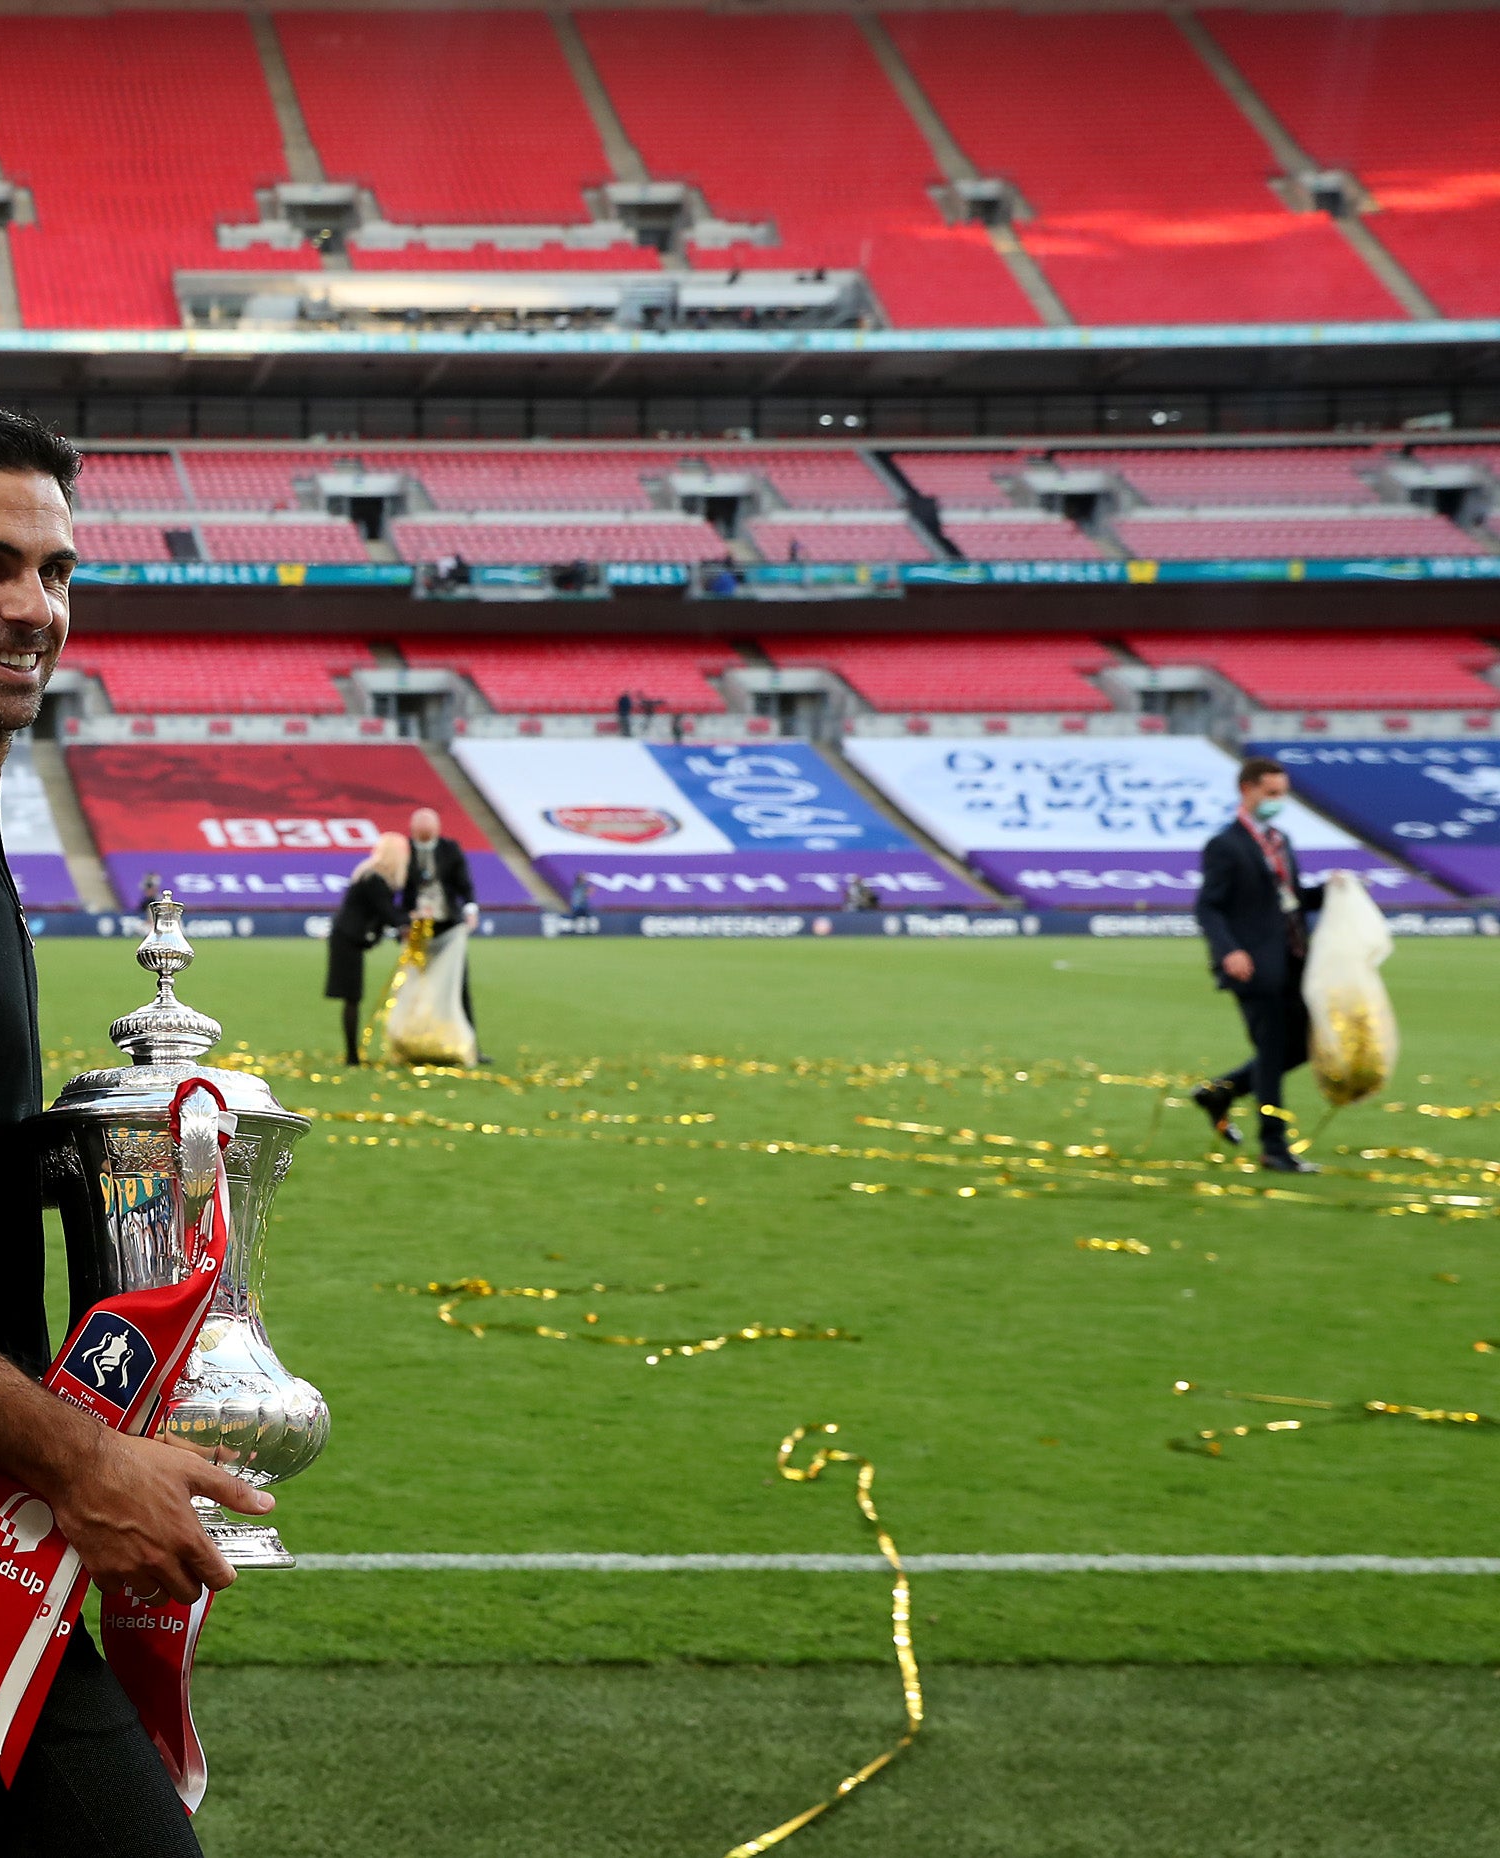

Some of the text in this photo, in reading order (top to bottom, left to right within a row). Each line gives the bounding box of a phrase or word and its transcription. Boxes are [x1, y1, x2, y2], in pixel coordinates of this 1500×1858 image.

[143, 563, 271, 584] WEMBLEY
[606, 564, 689, 584] MBLEY
[990, 561, 1122, 583] WEMBLEY
[1276, 747, 1499, 766] CHELSE
[198, 818, 378, 848] 1930
[173, 873, 352, 893] SILEN
[583, 872, 945, 892] WITH THE
[905, 915, 1019, 936] TheFA.com
[57, 1386, 110, 1425] Emirates
[80, 1390, 96, 1405] THE
[20, 1567, 45, 1595] Up
[36, 1602, 53, 1620] p
[56, 1620, 71, 1638] p
[104, 1613, 185, 1634] Heads Up
